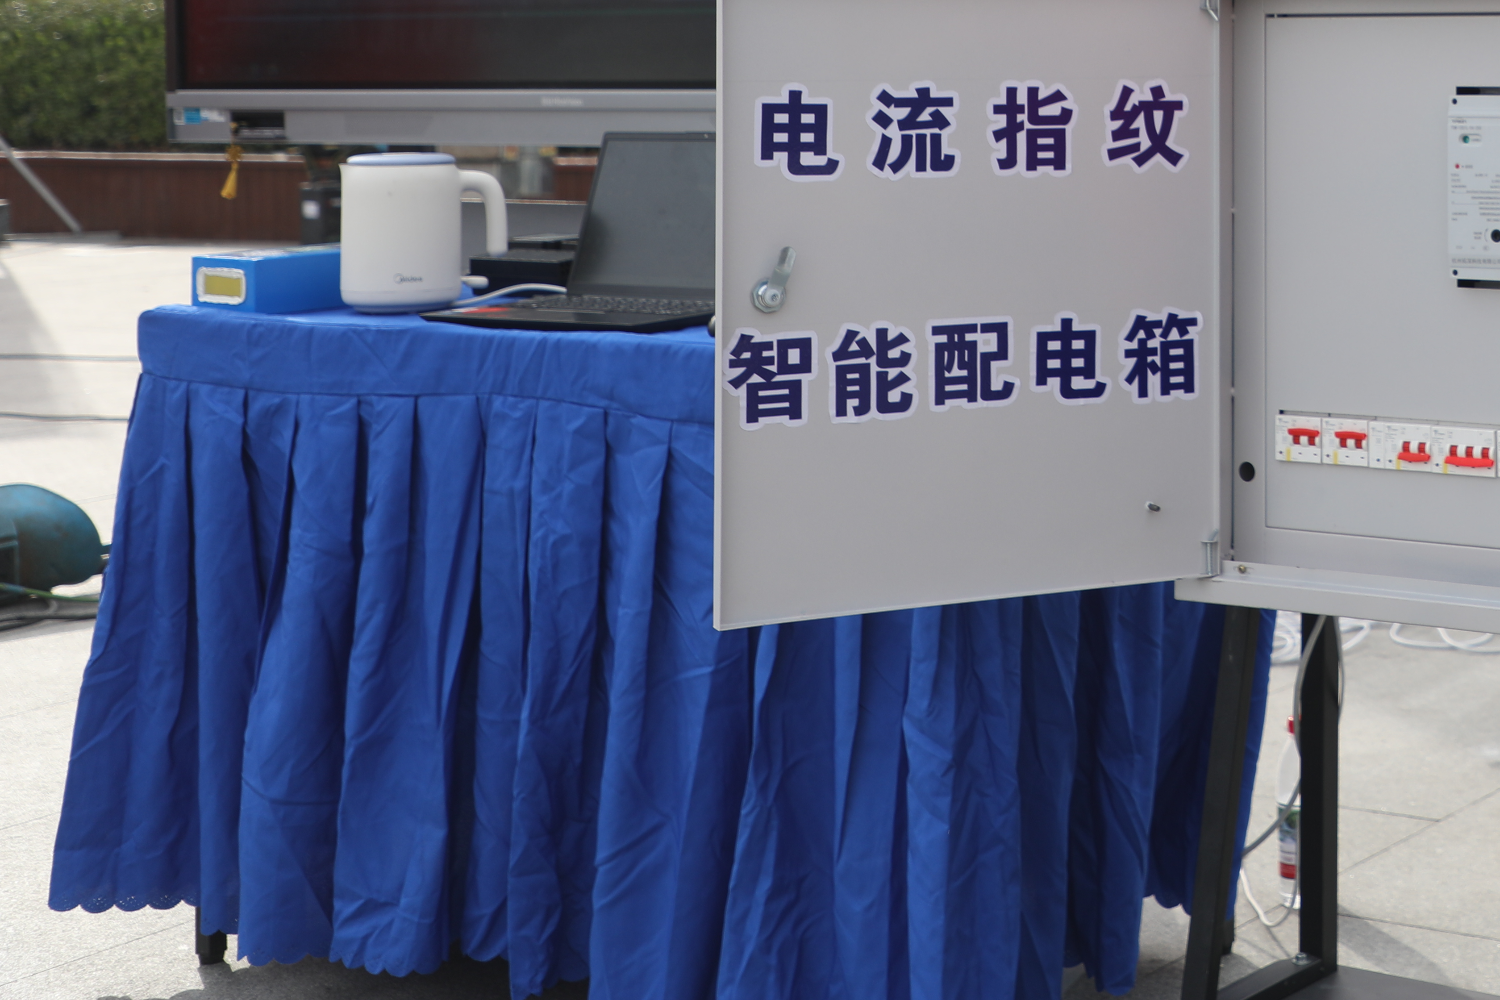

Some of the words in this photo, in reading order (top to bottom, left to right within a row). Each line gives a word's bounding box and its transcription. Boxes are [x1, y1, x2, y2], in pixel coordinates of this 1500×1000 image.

[759, 85, 1185, 177] 电流指纹
[727, 311, 1199, 425] 智能配电箱
